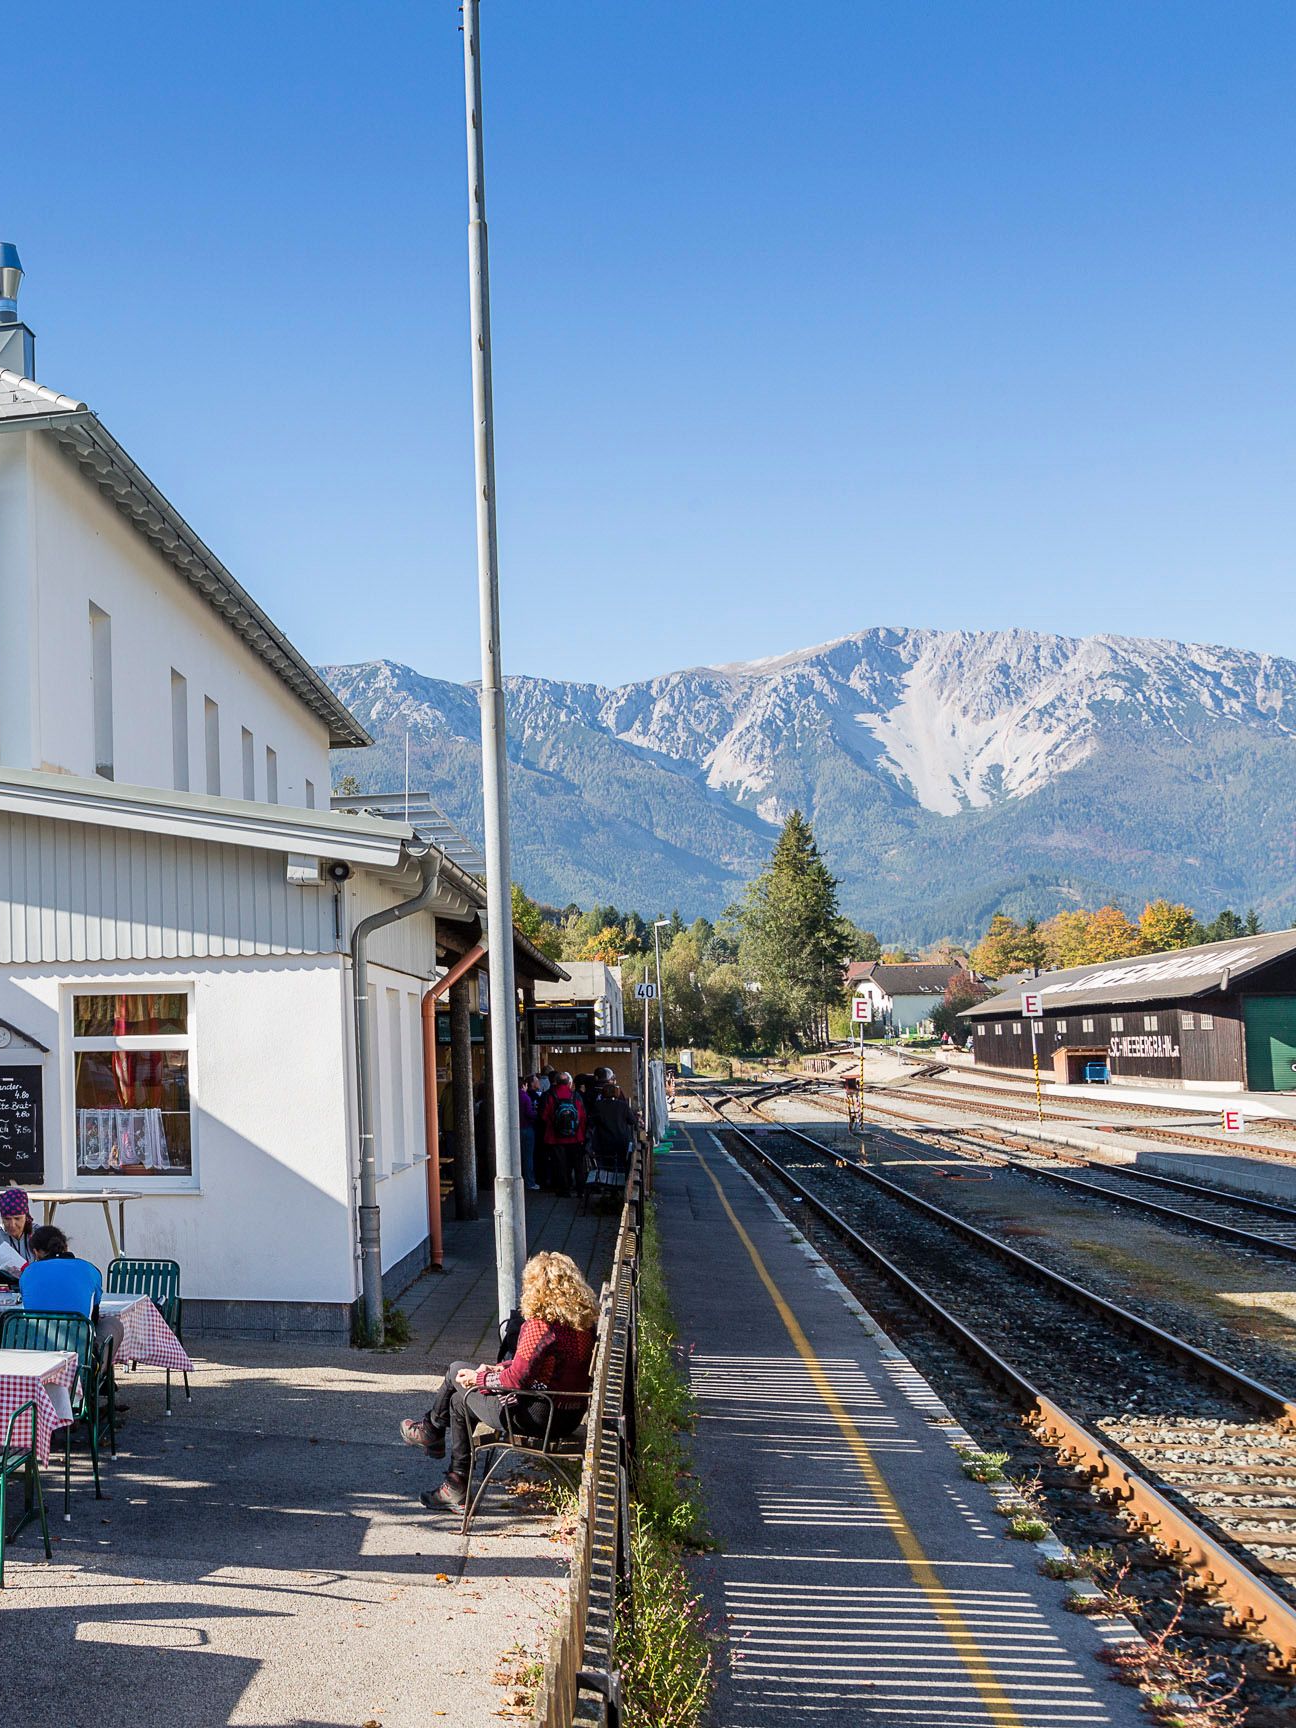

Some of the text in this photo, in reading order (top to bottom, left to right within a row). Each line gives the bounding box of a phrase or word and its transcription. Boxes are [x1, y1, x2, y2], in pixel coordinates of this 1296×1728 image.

[637, 984, 654, 998] 40
[856, 1001, 868, 1019] E
[1025, 995, 1039, 1013] E
[1225, 1111, 1240, 1130] E
